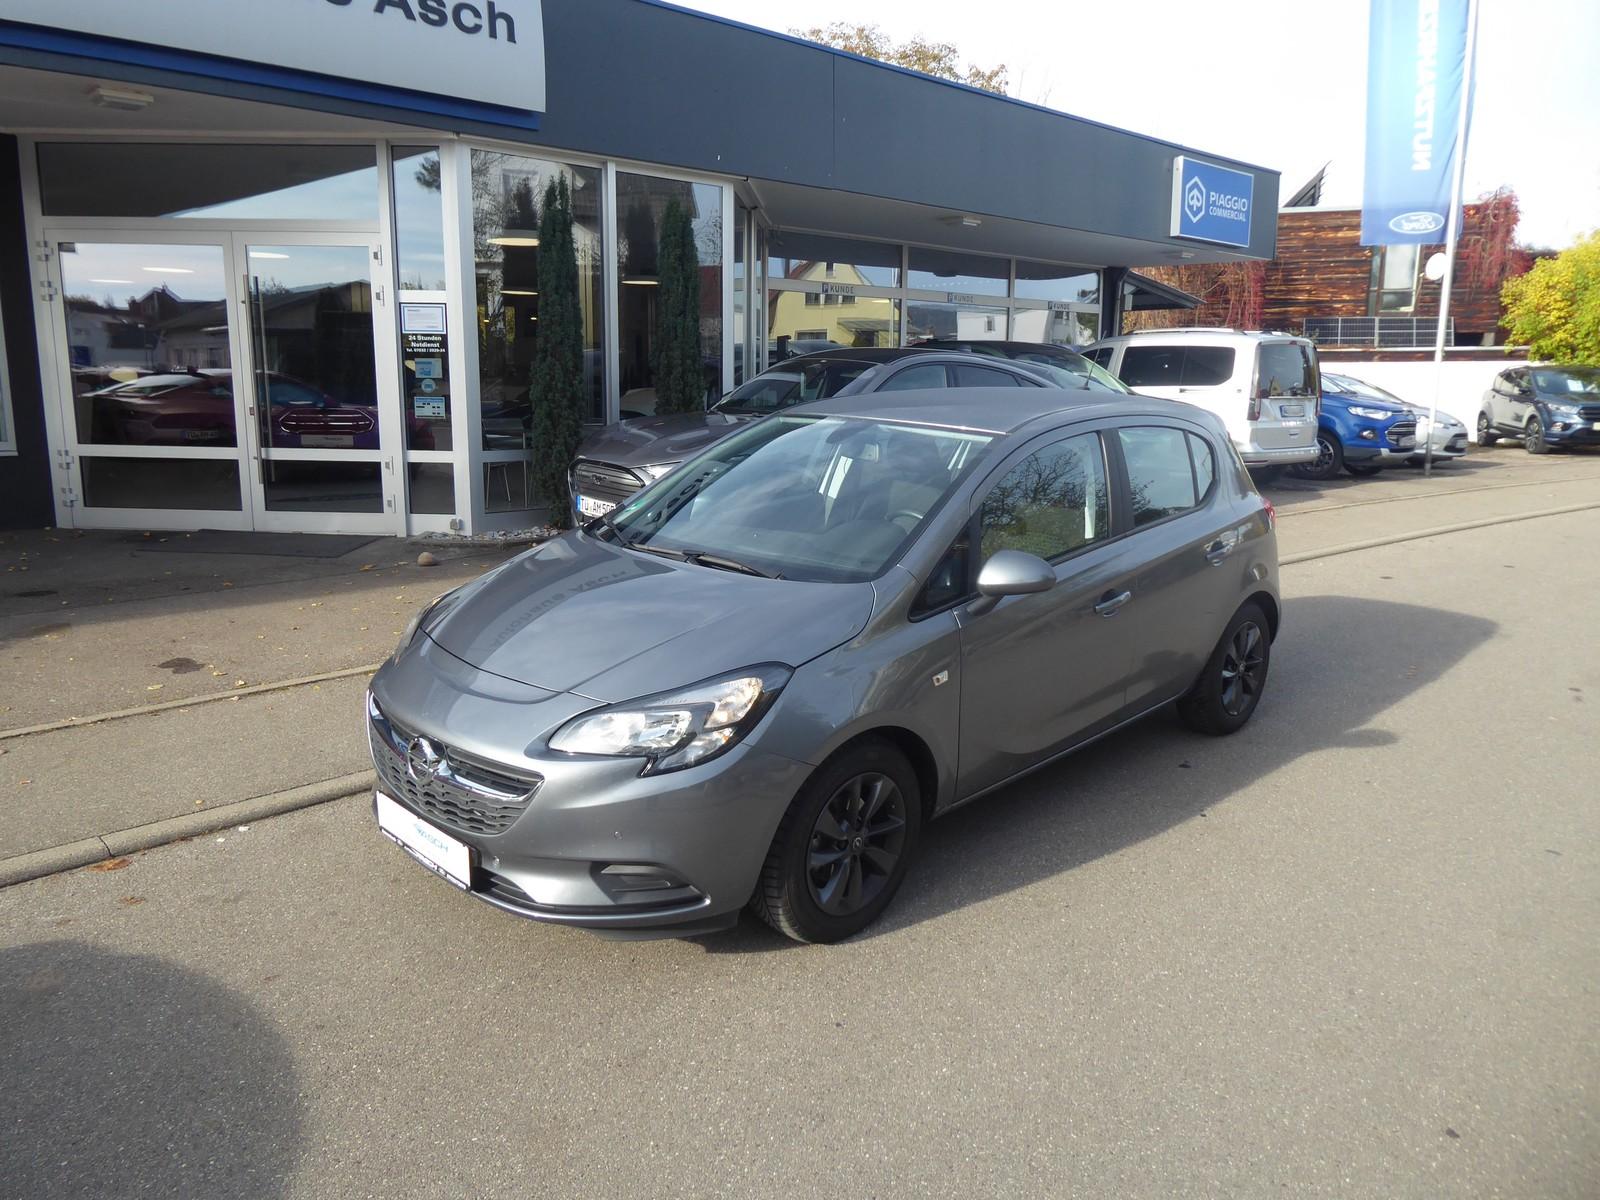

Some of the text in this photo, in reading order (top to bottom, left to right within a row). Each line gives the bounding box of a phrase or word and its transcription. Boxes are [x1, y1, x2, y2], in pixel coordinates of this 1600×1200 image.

[1209, 191, 1248, 212] PIAGGIO
[1209, 206, 1247, 222] COMMERCIAL
[830, 284, 854, 295] KUNDE
